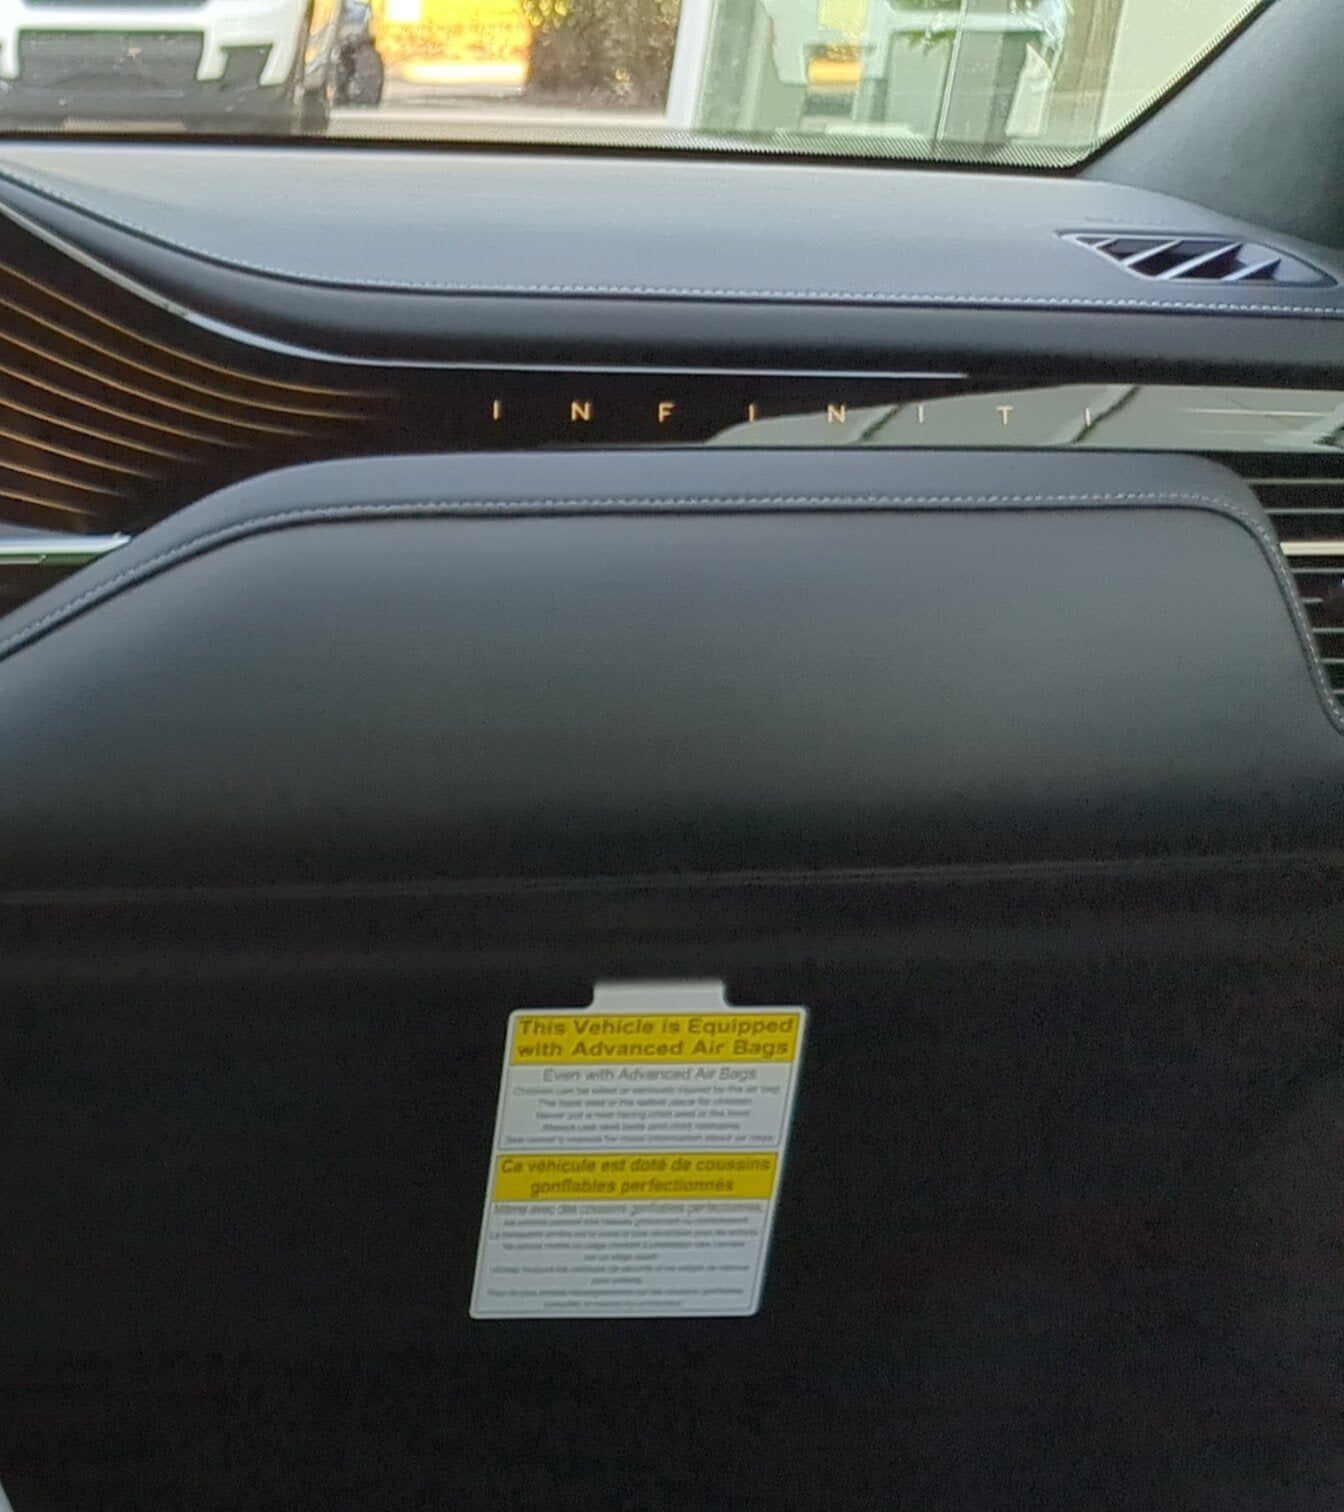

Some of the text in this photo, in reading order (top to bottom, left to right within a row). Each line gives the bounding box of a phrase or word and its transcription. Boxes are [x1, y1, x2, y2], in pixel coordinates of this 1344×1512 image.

[520, 1017, 794, 1037] This Vehicle is Equipped
[517, 1039, 789, 1060] with Advanced Air Bags
[618, 1067, 691, 1082] Advanced
[500, 1159, 523, 1174] Ce
[601, 1158, 626, 1173] est
[670, 1157, 692, 1172] de
[695, 1156, 771, 1172] coussins
[529, 1178, 616, 1198] gonflables
